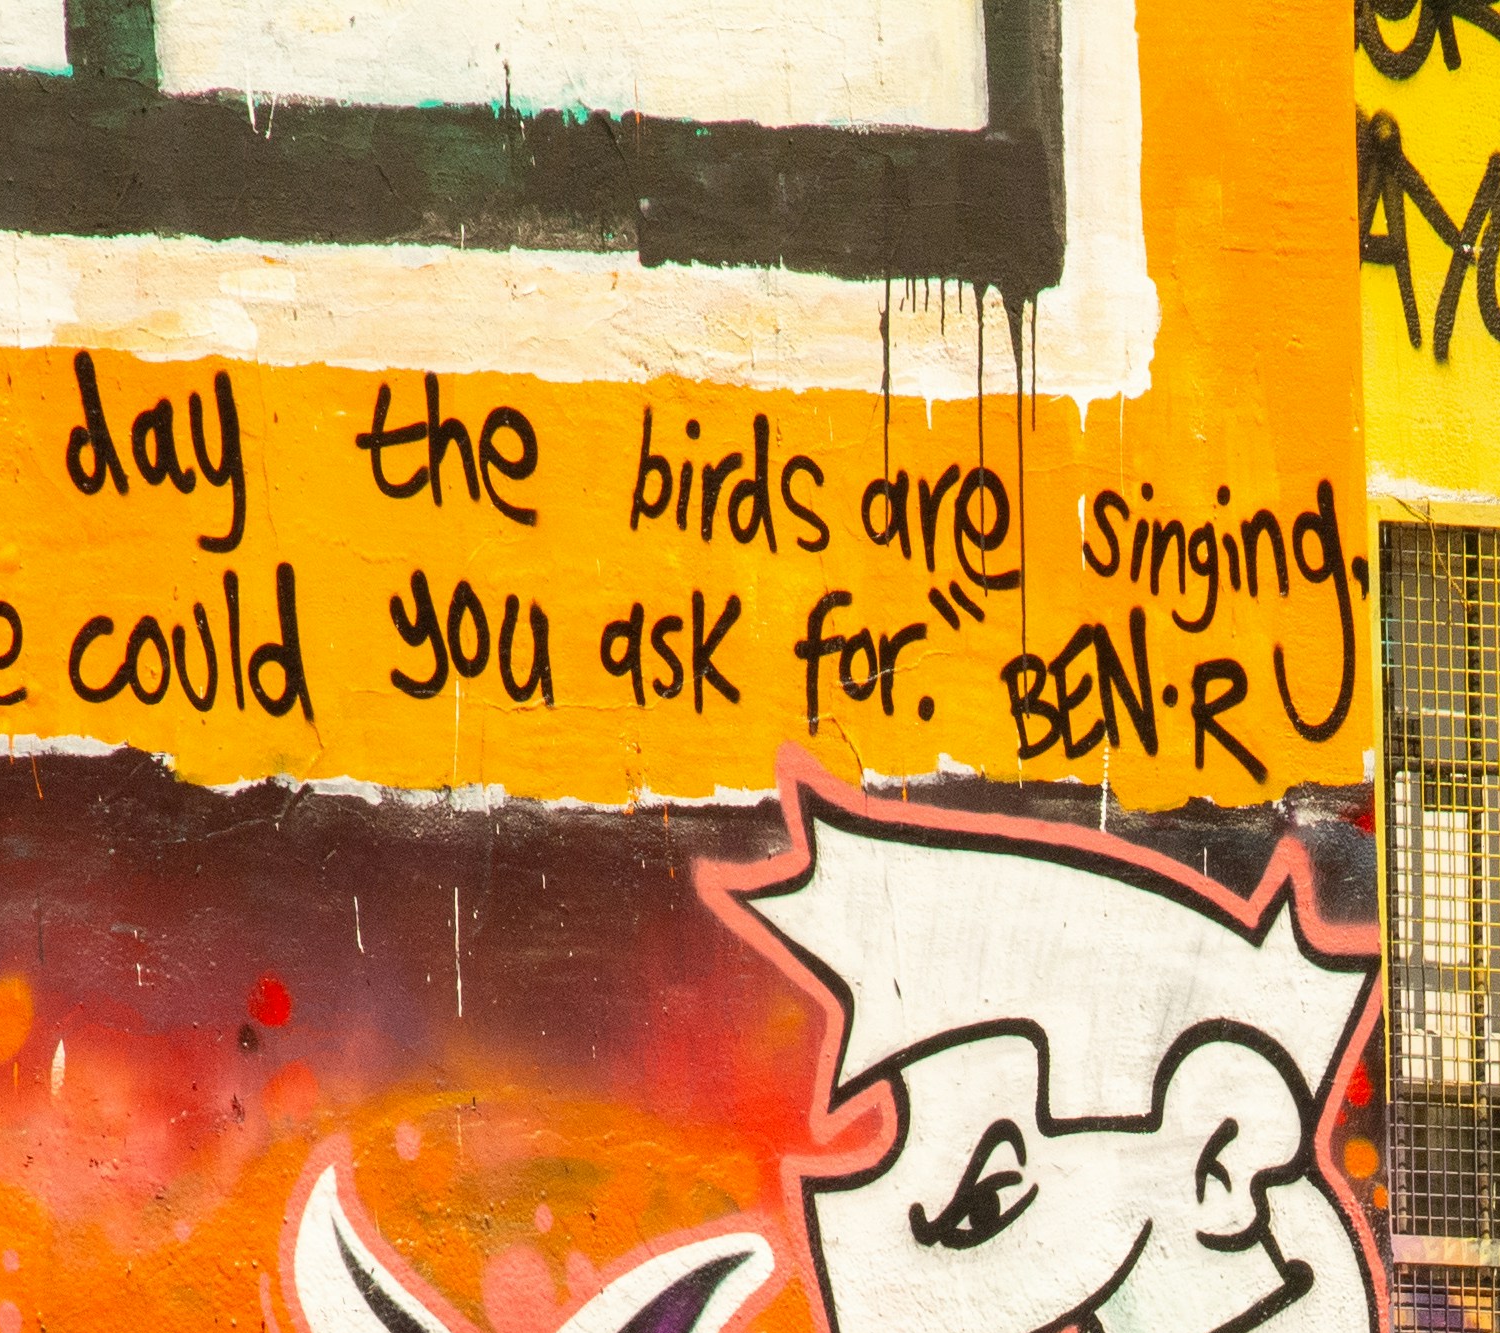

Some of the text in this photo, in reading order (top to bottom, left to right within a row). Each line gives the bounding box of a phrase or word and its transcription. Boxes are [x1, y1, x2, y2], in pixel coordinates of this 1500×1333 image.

[68, 352, 246, 553] day
[356, 372, 538, 526] the
[632, 405, 830, 553] birds
[861, 464, 1025, 591] are
[68, 560, 315, 722] could
[390, 569, 554, 708] you
[599, 590, 742, 713] ask
